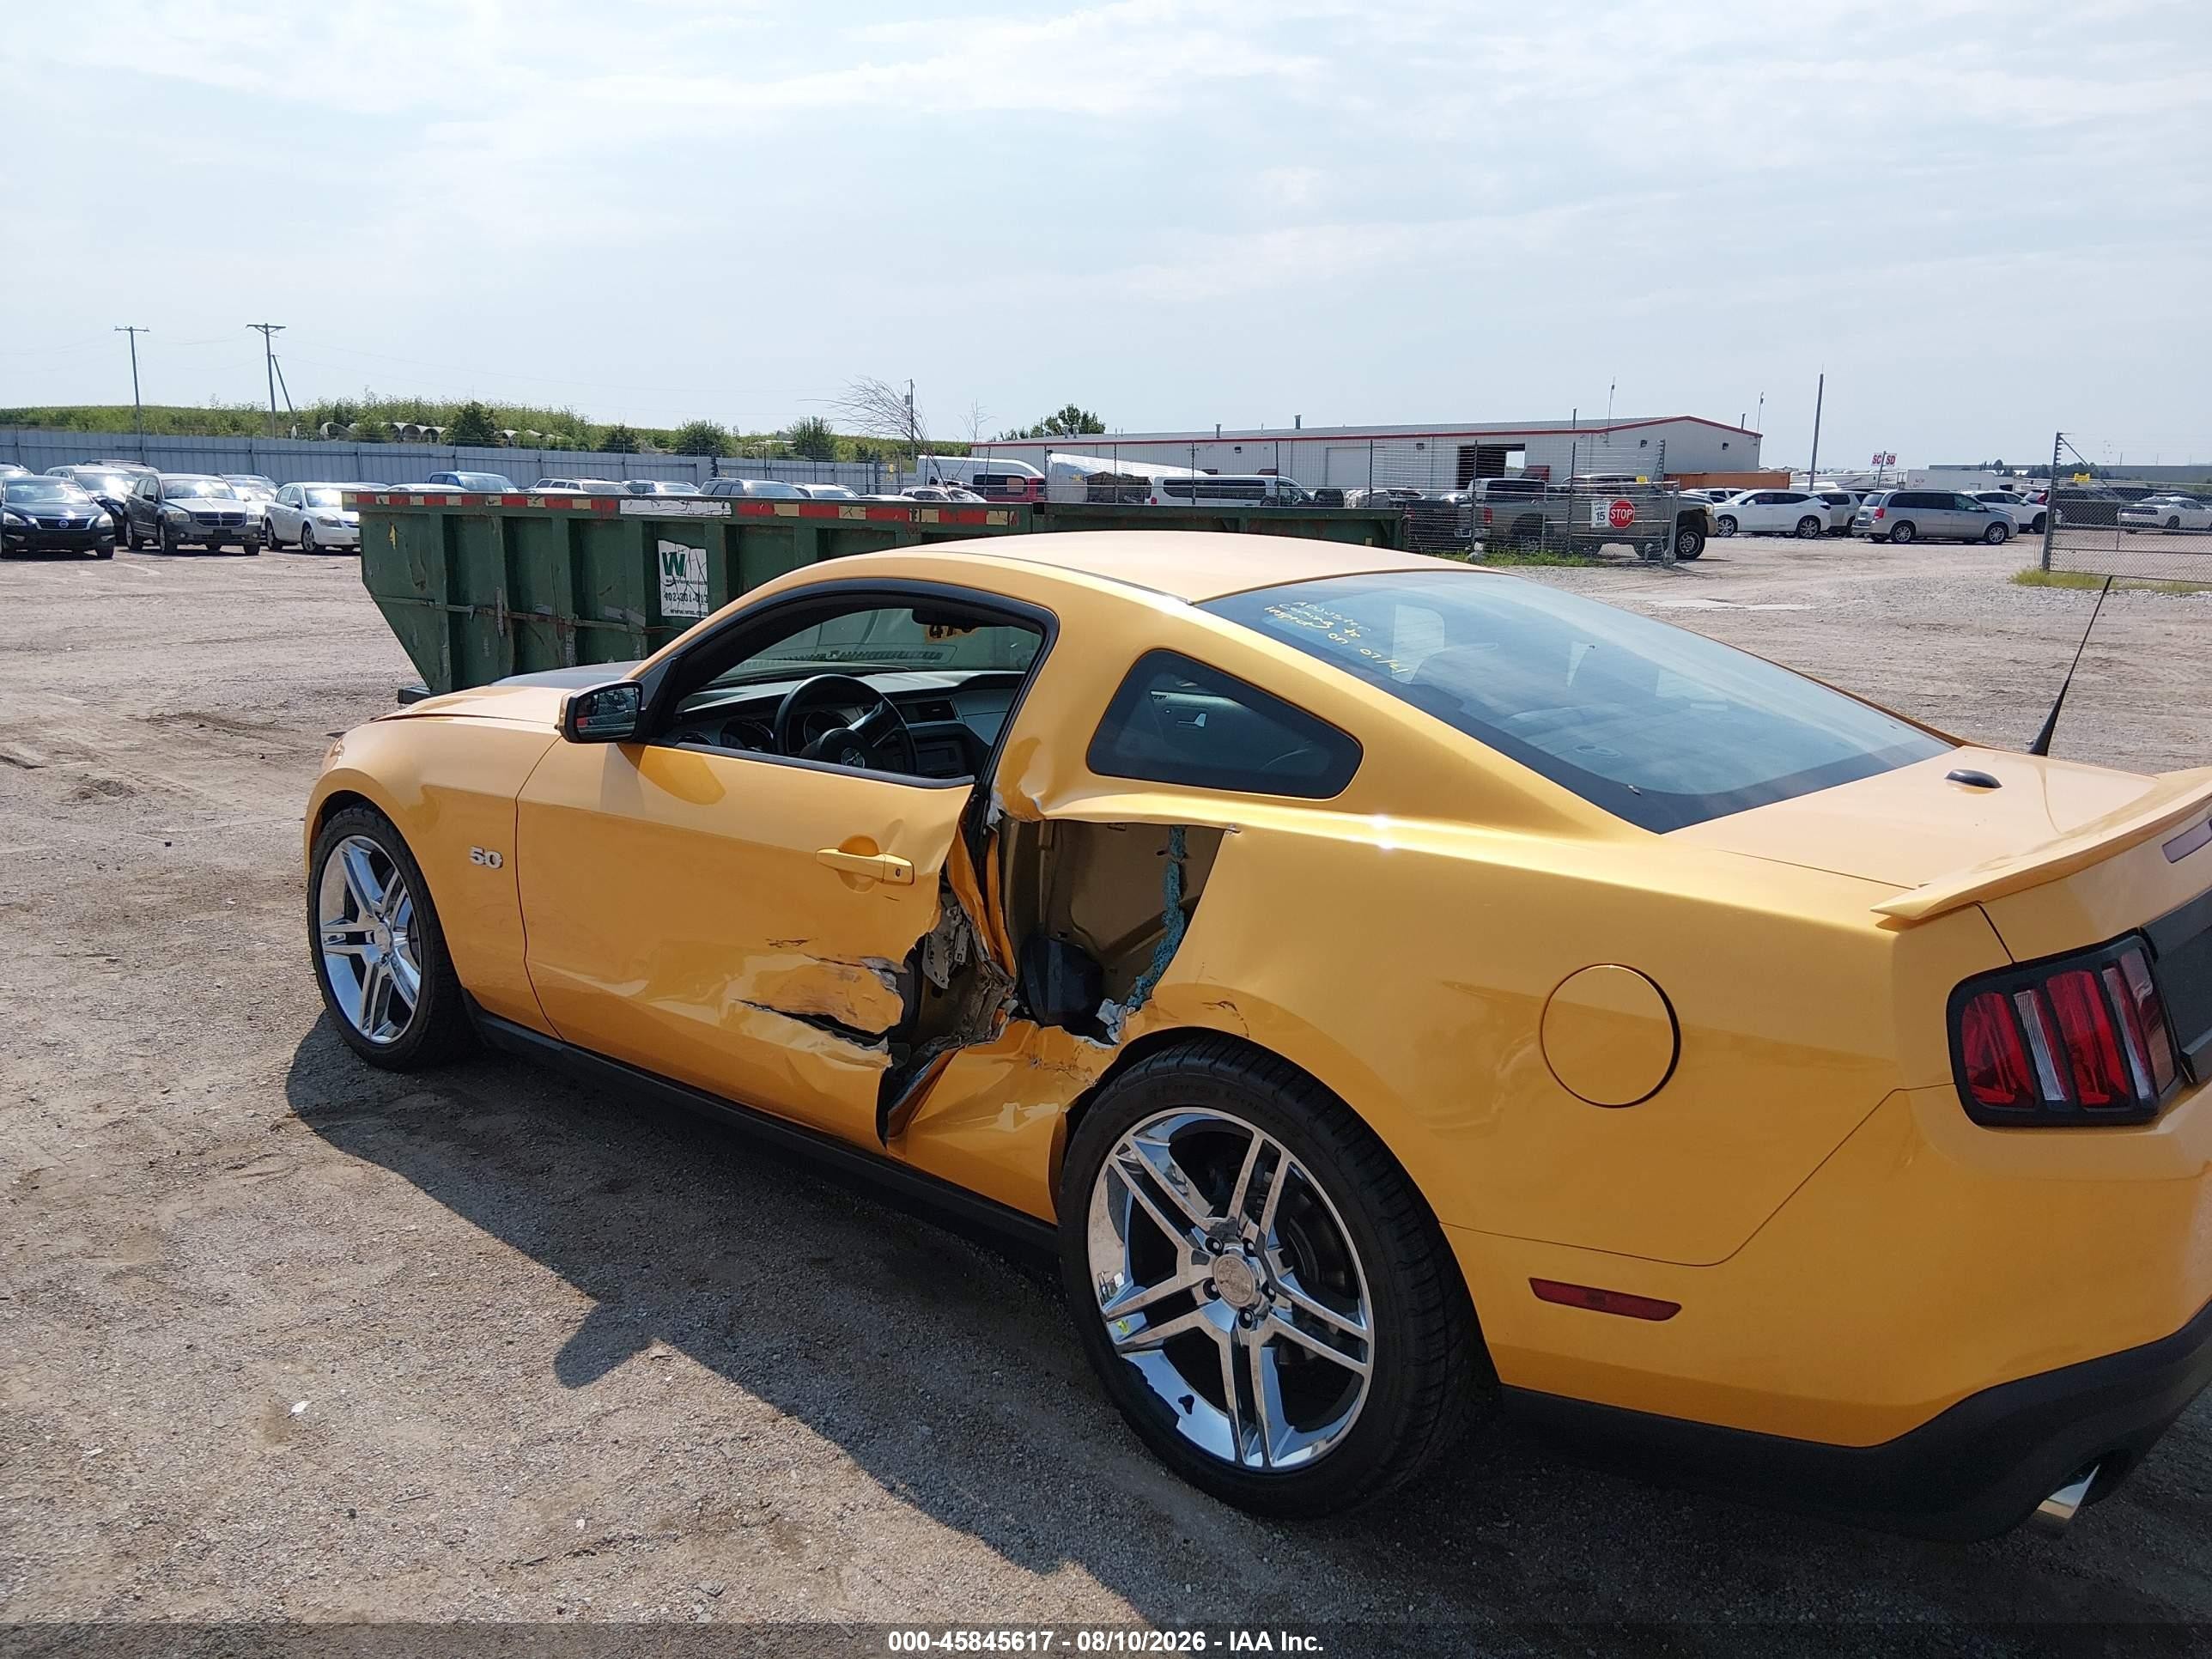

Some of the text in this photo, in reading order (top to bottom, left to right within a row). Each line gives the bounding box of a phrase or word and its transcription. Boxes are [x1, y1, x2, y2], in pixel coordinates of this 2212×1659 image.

[1872, 454, 1882, 465] SC
[1886, 455, 1896, 465] SD
[1595, 512, 1606, 521] 15
[1610, 508, 1633, 519] STOP
